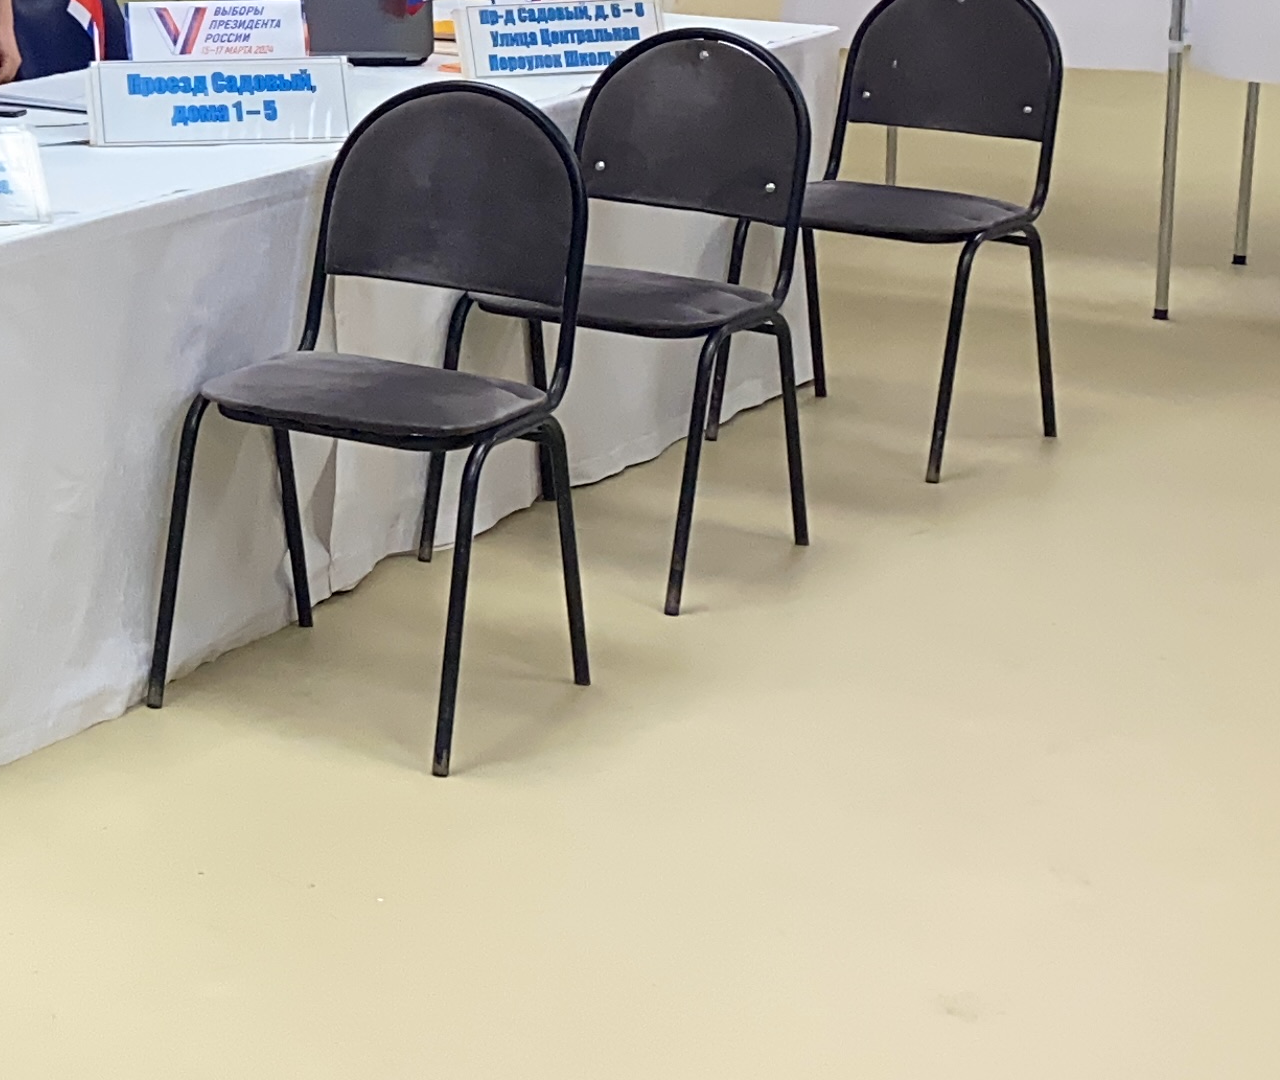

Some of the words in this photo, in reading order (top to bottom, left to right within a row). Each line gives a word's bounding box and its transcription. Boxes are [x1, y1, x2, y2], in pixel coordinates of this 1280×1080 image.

[213, 5, 265, 17] ВЫБОРЫ
[208, 18, 281, 31] ПРЕЗИДЕНТА
[204, 32, 251, 43] РОССИИ
[490, 30, 538, 49] Улица
[126, 73, 209, 96] Проезд
[211, 69, 317, 95] Садовый,
[171, 104, 230, 126] дома
[231, 100, 244, 122] 1
[263, 100, 278, 121] 5
